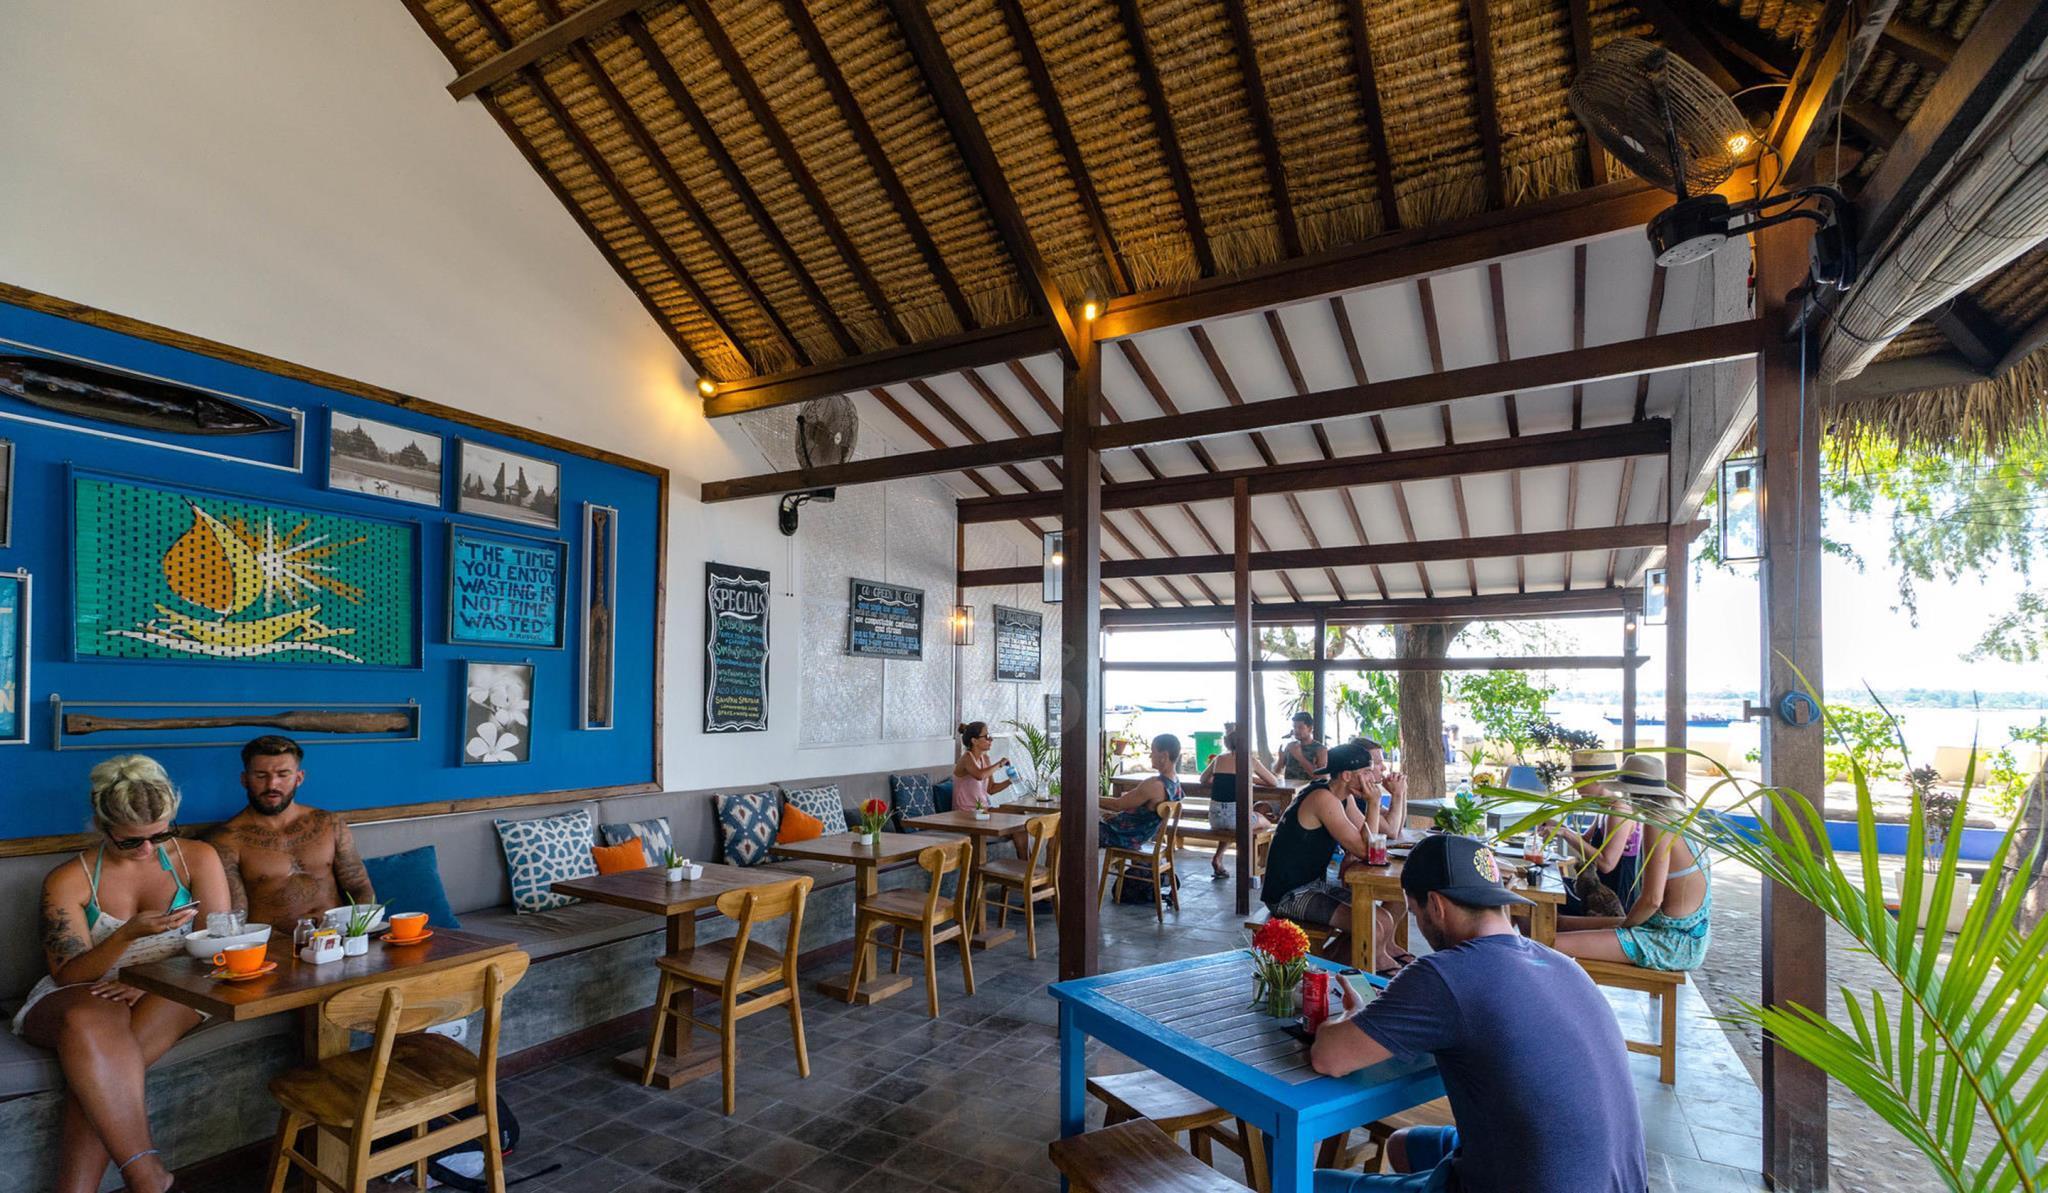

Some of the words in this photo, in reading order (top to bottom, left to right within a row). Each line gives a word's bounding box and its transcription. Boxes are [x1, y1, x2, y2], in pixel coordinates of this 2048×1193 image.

[512, 548, 555, 570] TIME
[462, 560, 501, 579] YOU
[507, 565, 557, 586] ENJOY
[457, 576, 537, 601] WASTING
[541, 586, 555, 604] IS
[714, 588, 765, 614] SPECIALS
[462, 595, 503, 612] NOT
[508, 599, 547, 618] TIME
